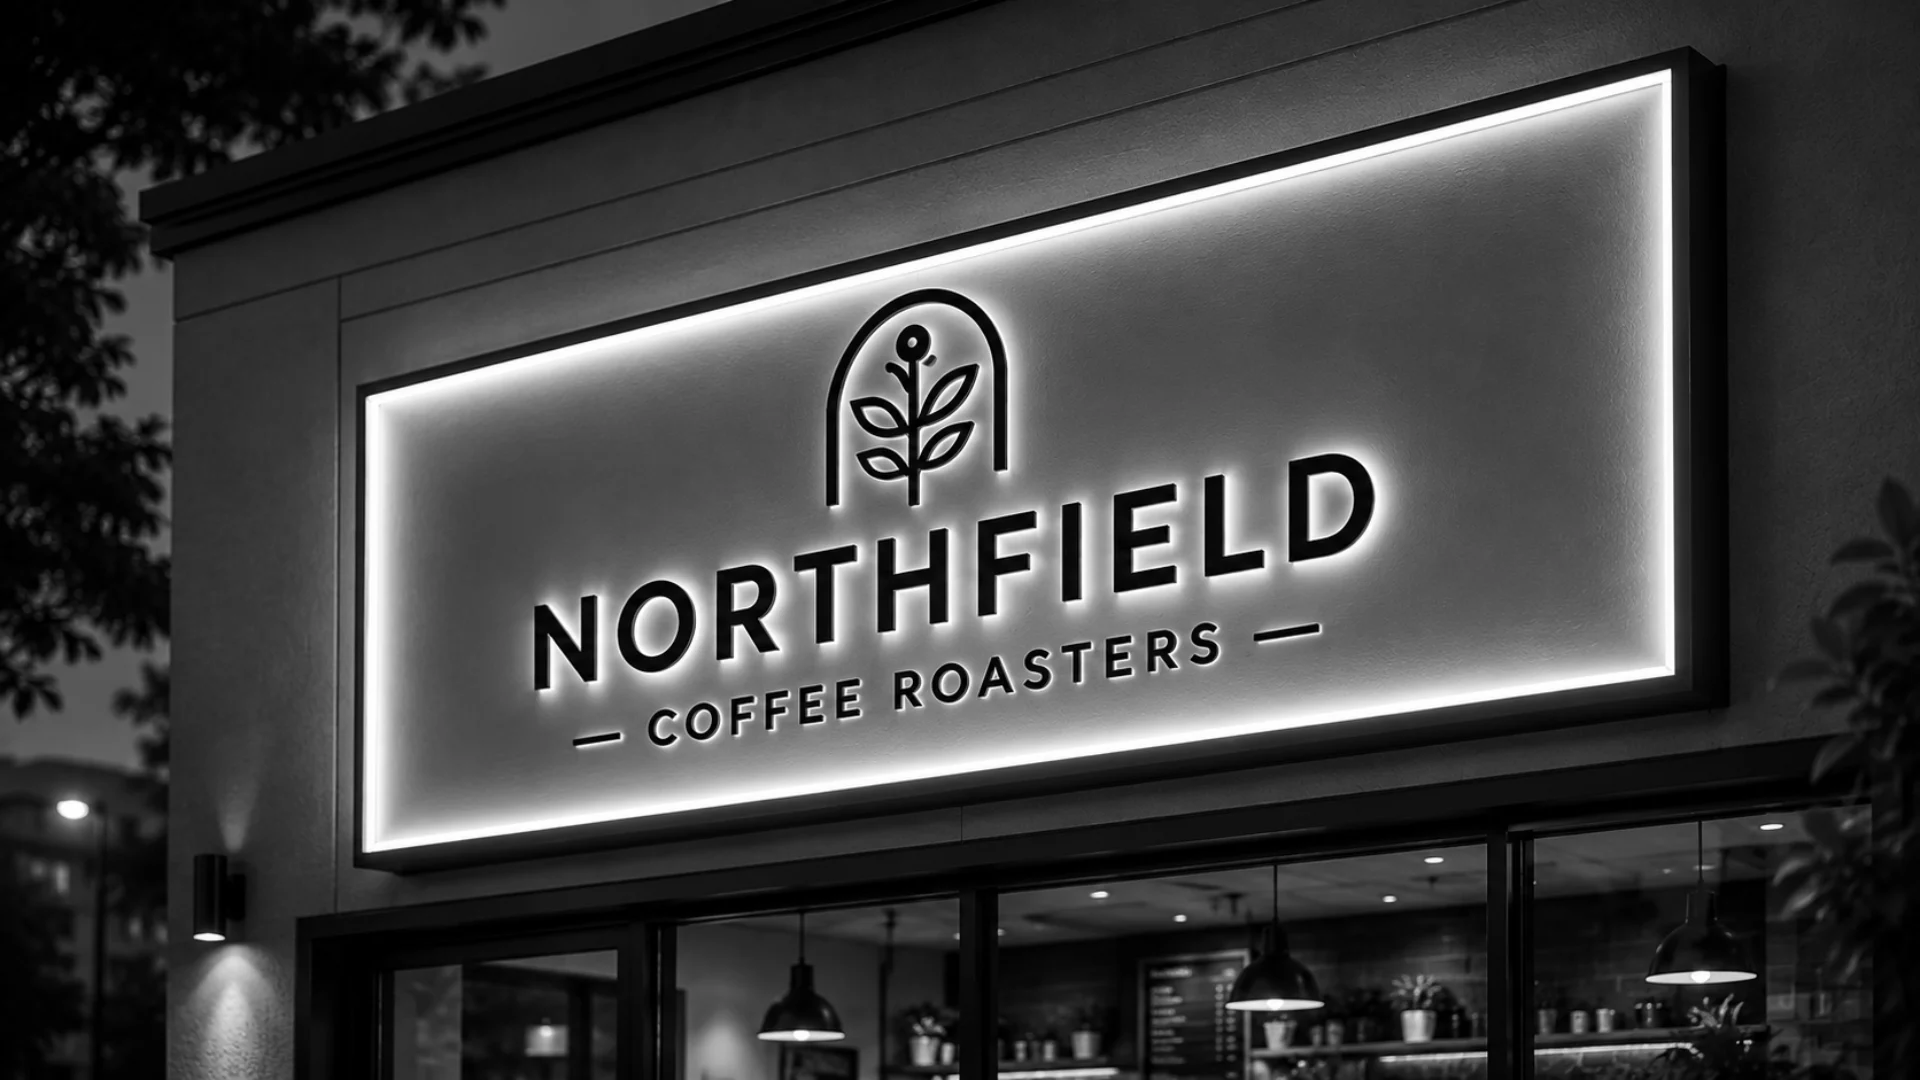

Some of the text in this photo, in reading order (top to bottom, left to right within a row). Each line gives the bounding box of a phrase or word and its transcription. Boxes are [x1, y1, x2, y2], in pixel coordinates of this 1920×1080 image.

[534, 453, 1375, 690] NORTHFIELD
[648, 622, 1220, 746] COFFEE ROASTERS
